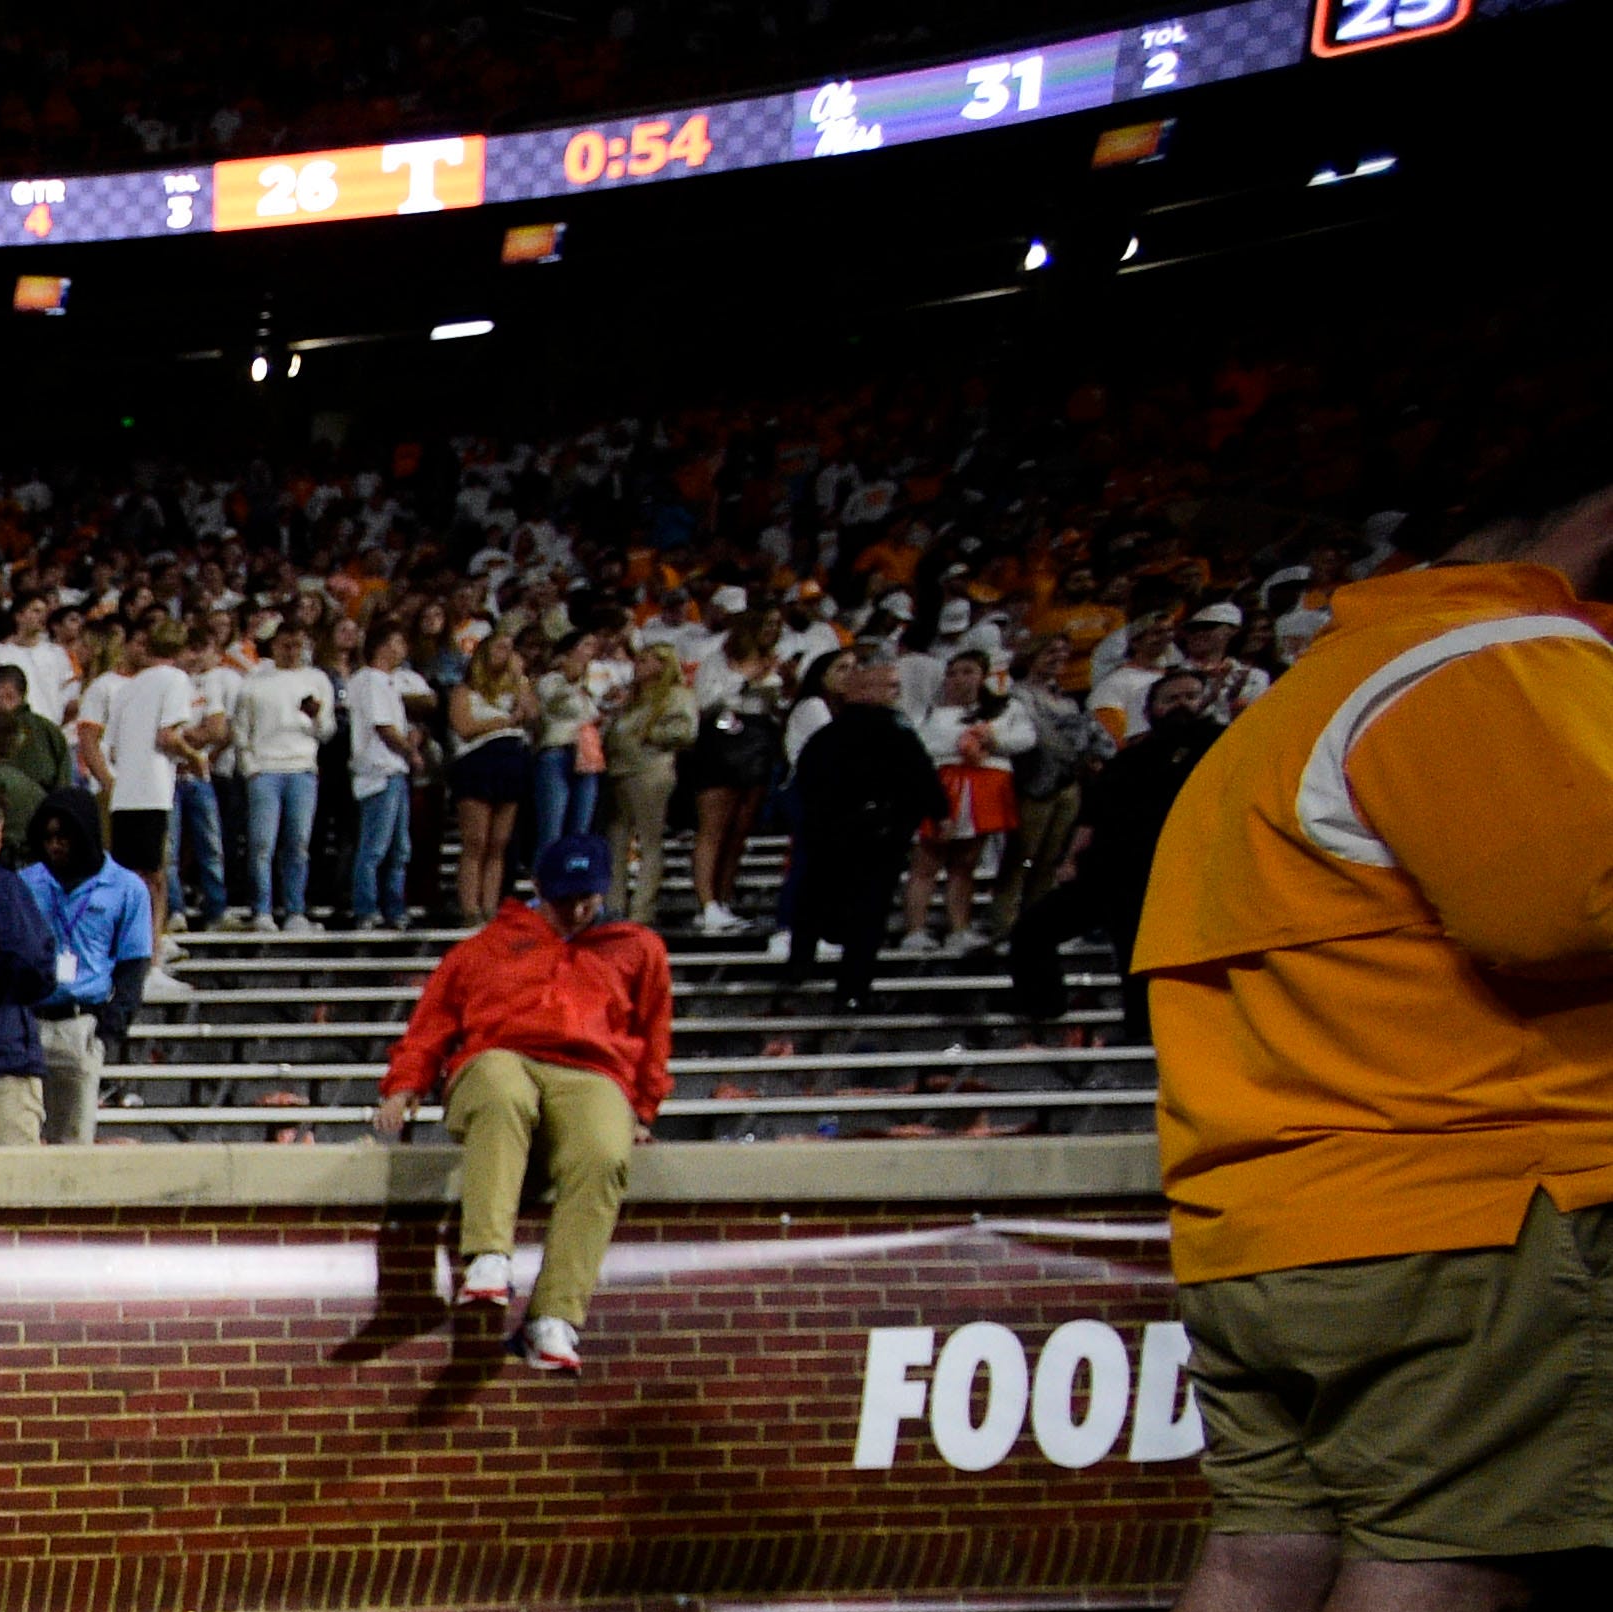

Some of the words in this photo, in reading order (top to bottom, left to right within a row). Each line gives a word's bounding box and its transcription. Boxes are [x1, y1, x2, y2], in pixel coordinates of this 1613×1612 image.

[1141, 28, 1188, 50] TOL
[960, 55, 1045, 120] 31
[1141, 50, 1180, 90] 2
[563, 114, 713, 185] 0:54
[11, 179, 66, 206] QTR
[255, 160, 339, 217] 26
[23, 203, 54, 238] 4
